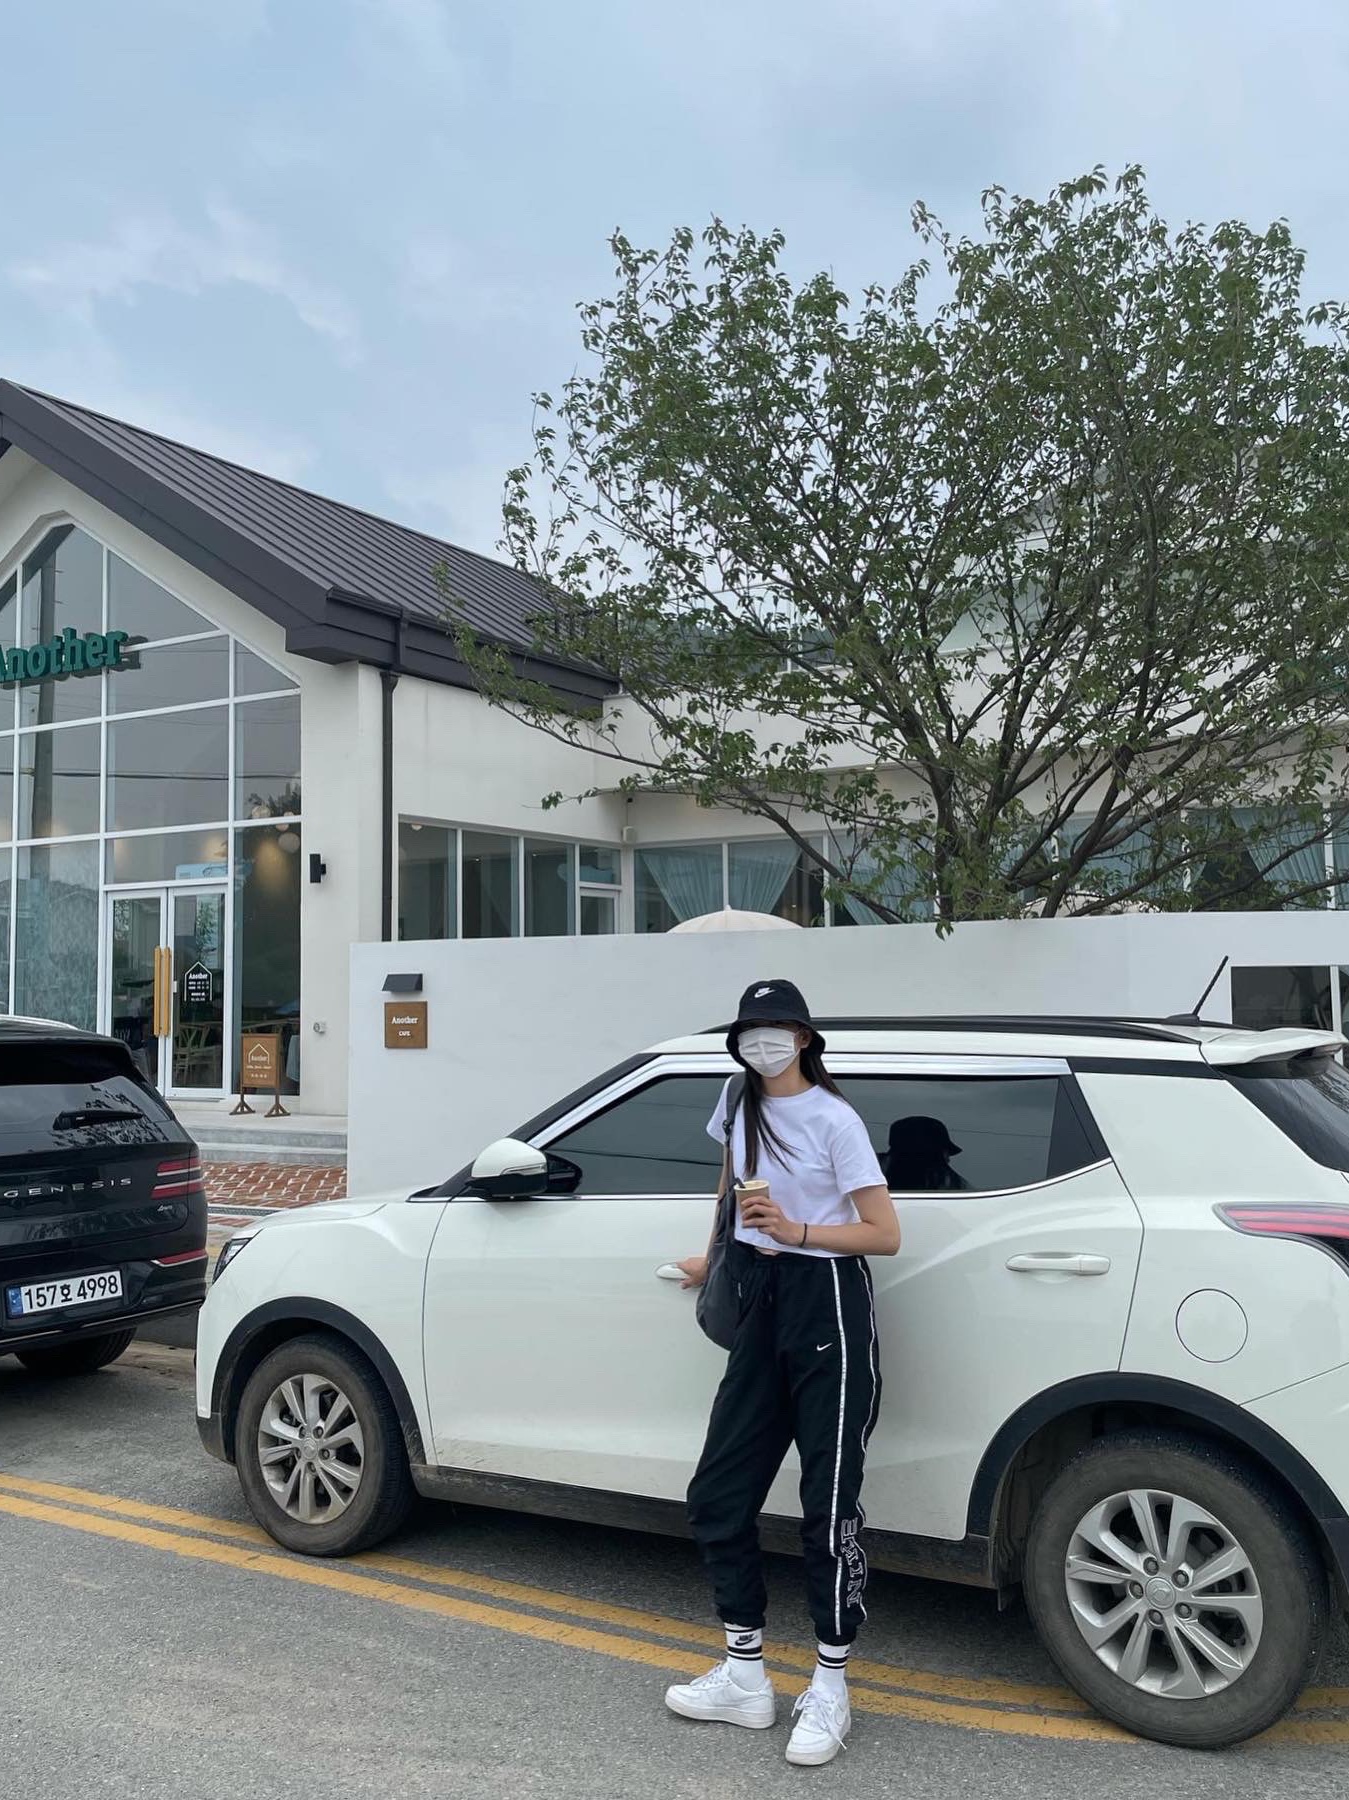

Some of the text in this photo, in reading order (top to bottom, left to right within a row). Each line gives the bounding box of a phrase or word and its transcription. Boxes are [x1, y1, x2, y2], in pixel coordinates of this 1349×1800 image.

[391, 1016, 417, 1024] Another
[4, 1178, 131, 1197] GENESIS
[25, 1275, 118, 1309] 157호 4998
[841, 1517, 863, 1608] NIKE
